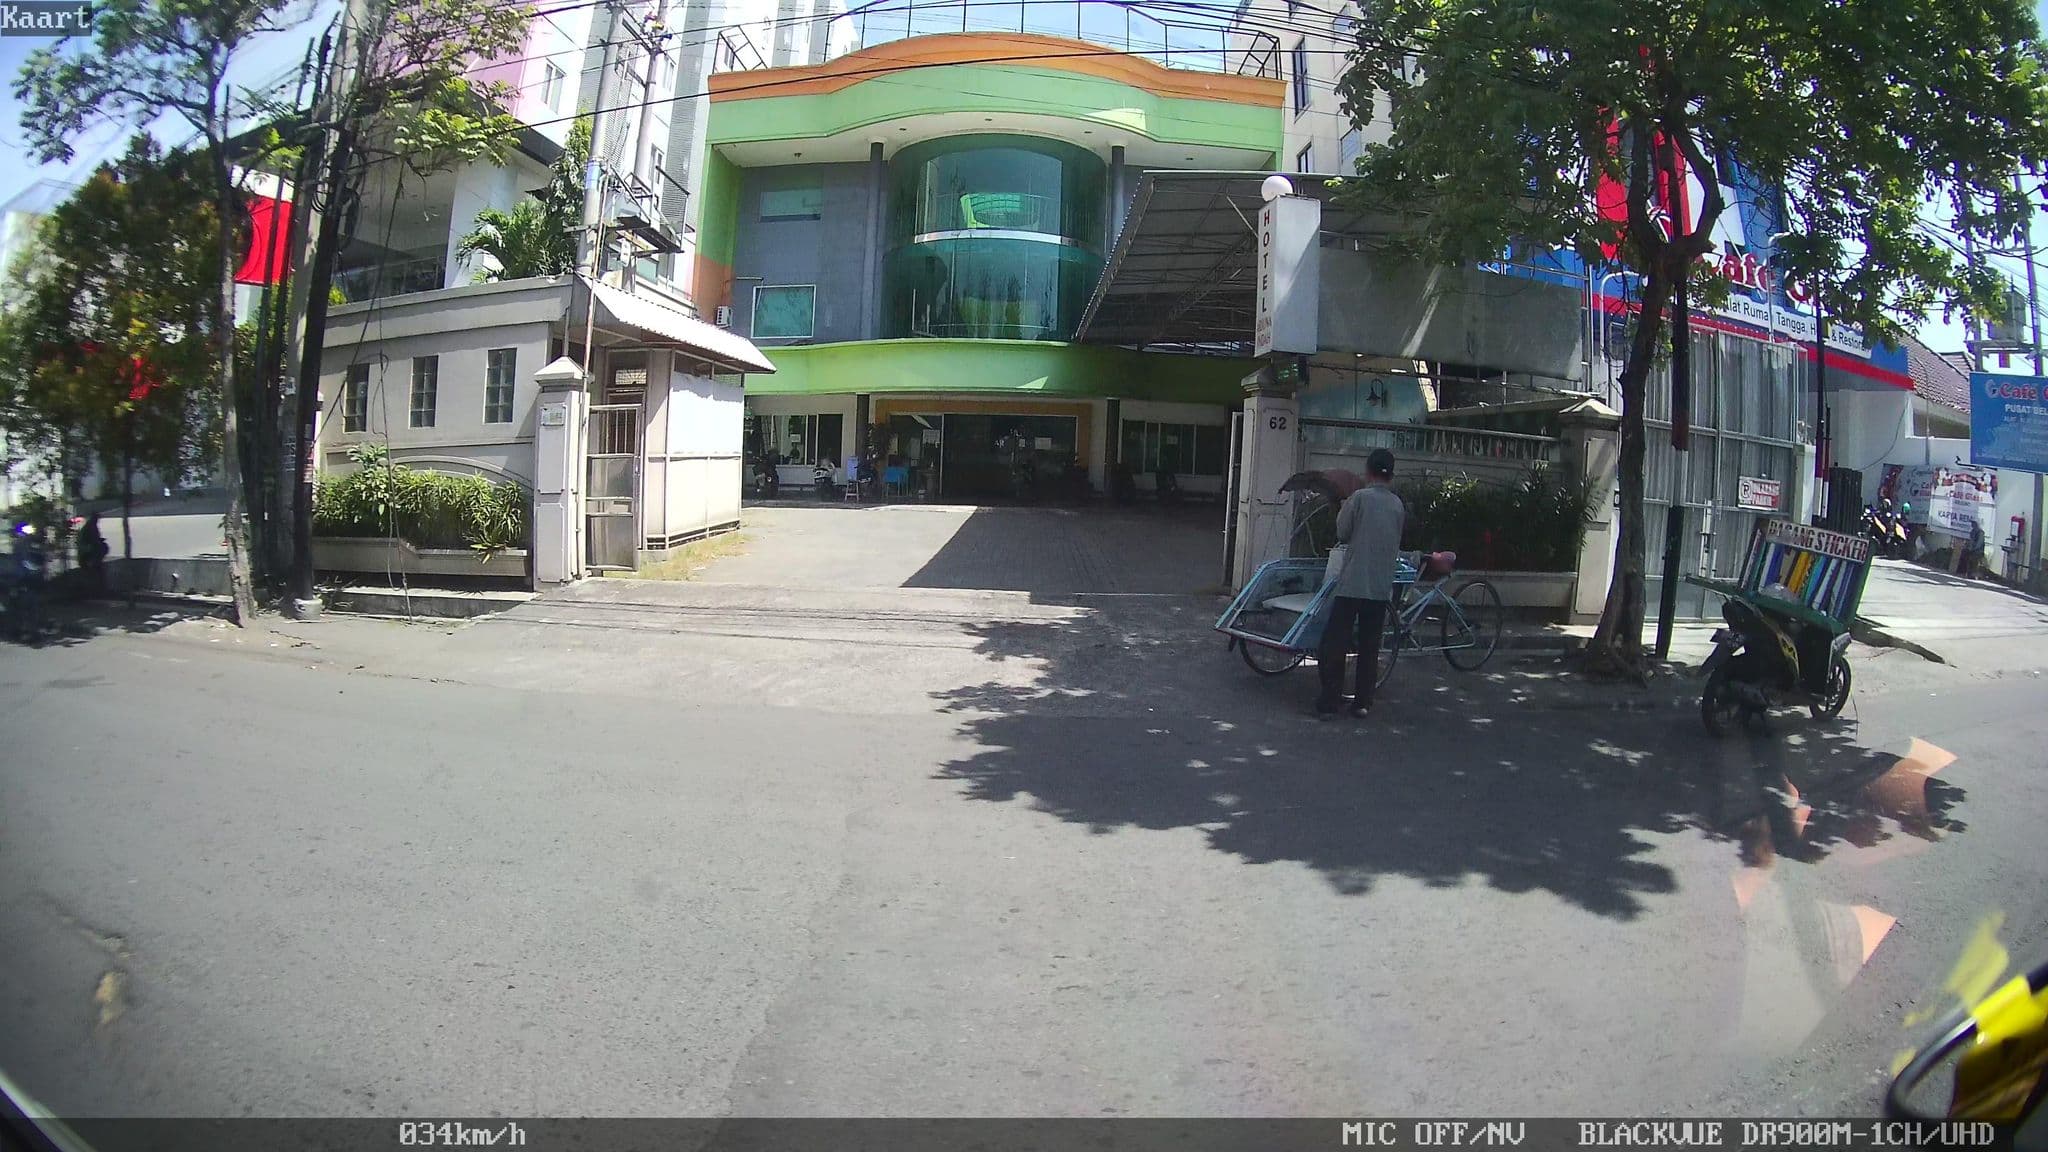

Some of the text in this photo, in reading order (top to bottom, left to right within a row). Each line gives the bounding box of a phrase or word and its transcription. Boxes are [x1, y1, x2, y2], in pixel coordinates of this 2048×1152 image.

[1261, 209, 1271, 313] HOTEL
[1269, 416, 1287, 431] 62
[1815, 531, 1868, 563] STICKER
